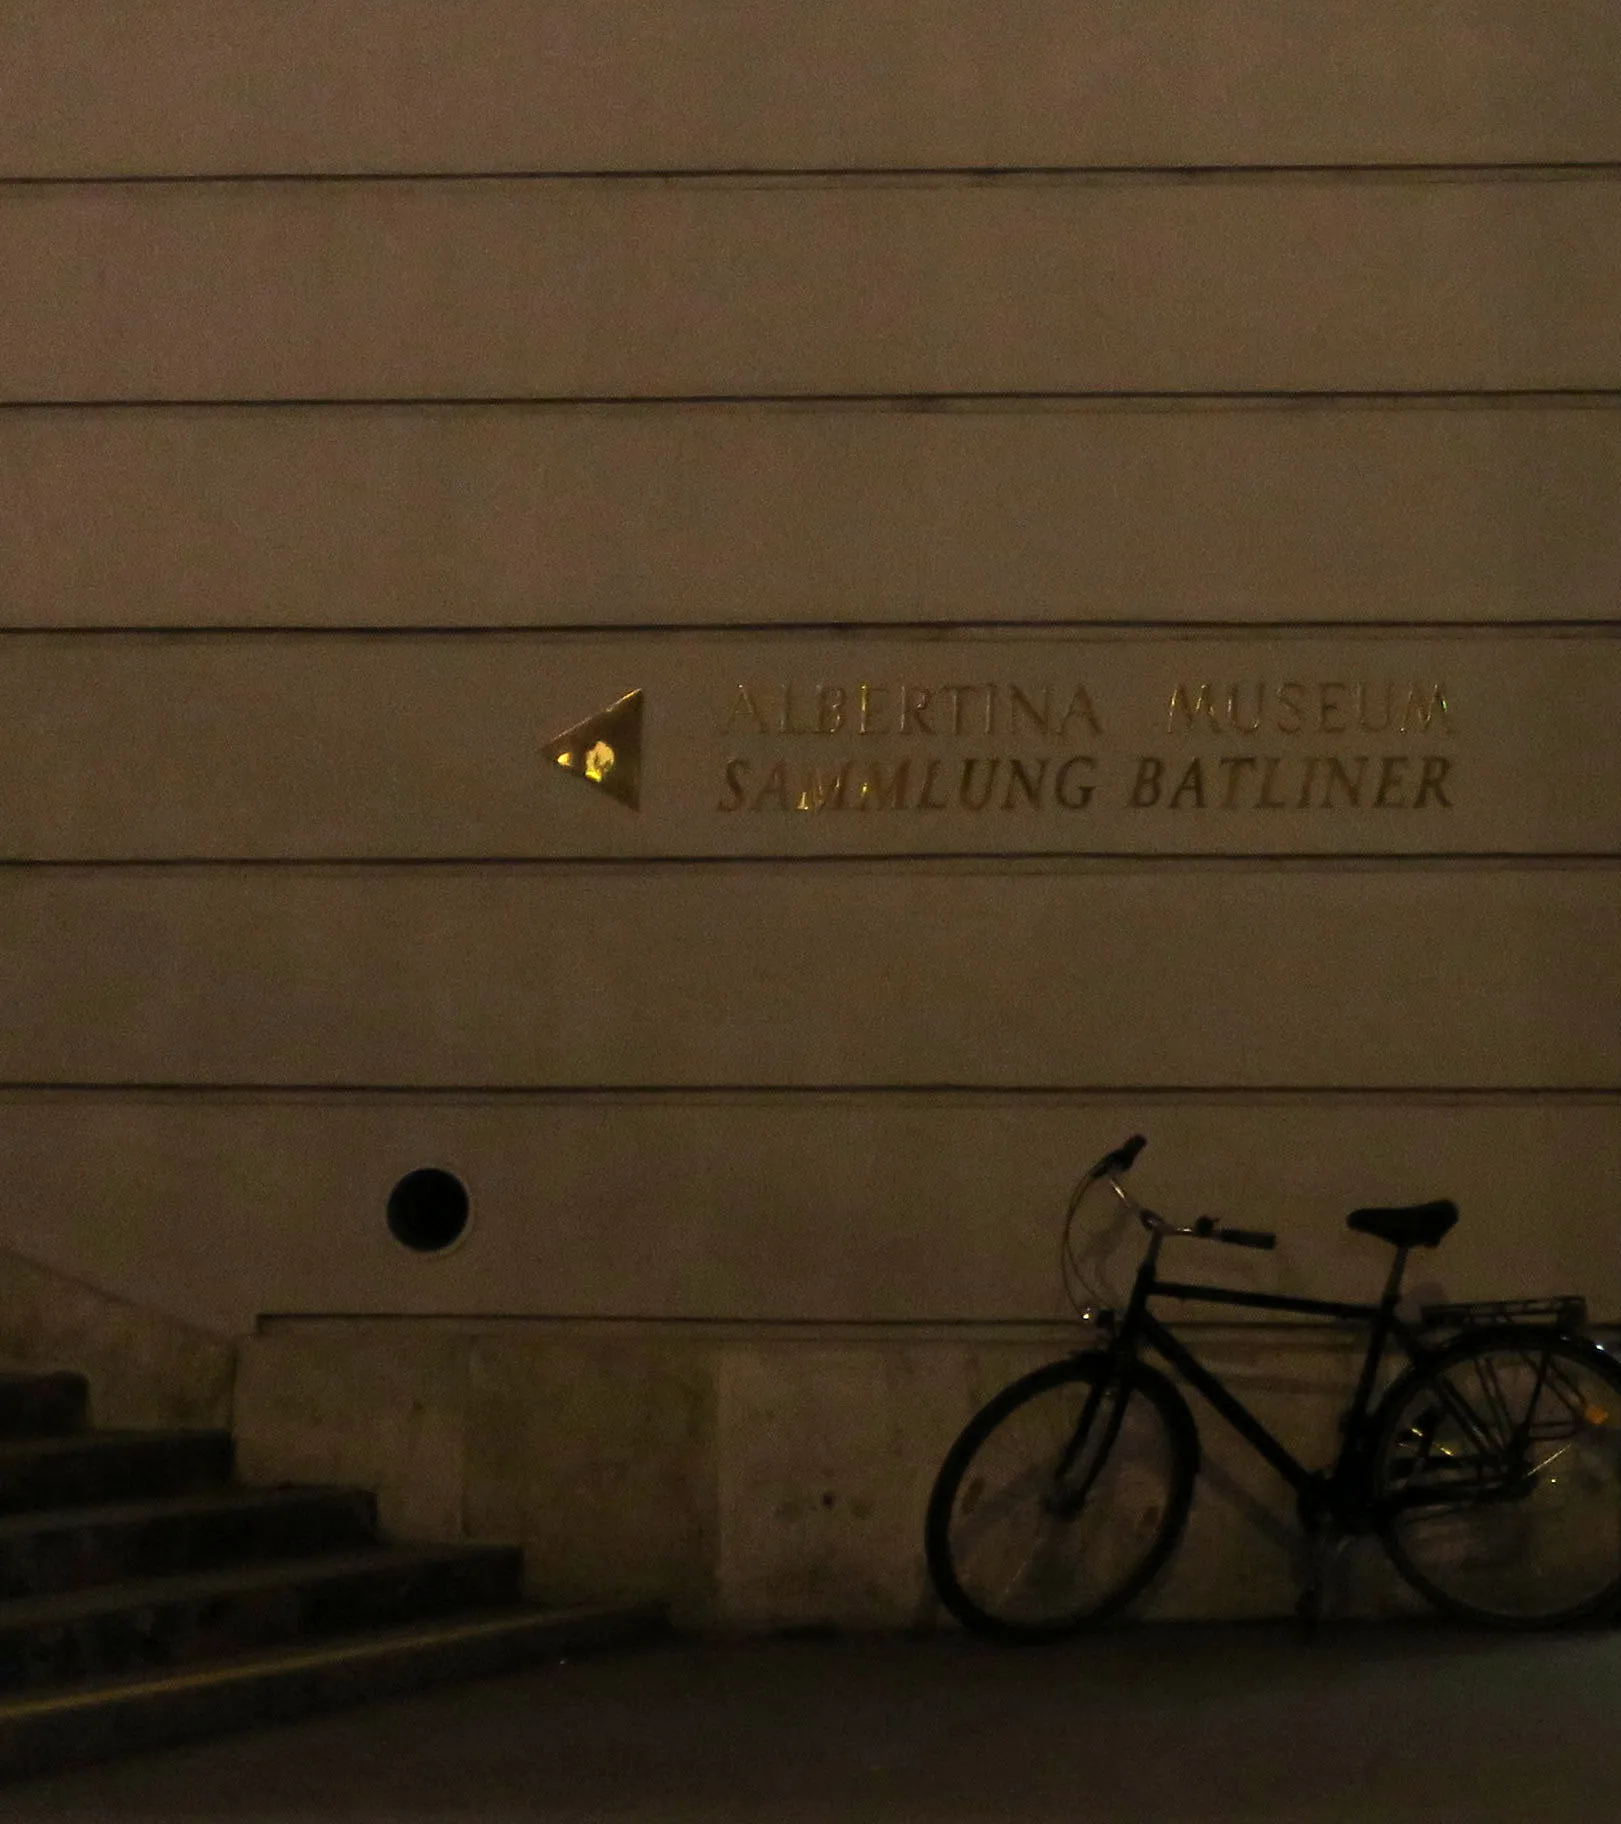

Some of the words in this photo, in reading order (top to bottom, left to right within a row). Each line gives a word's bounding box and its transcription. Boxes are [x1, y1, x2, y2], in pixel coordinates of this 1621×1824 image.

[717, 682, 1106, 738] ALBERTINA
[1166, 680, 1456, 736] MUSEUM
[715, 755, 1099, 814] SAMMLUNG
[1127, 753, 1455, 811] BATLINER
